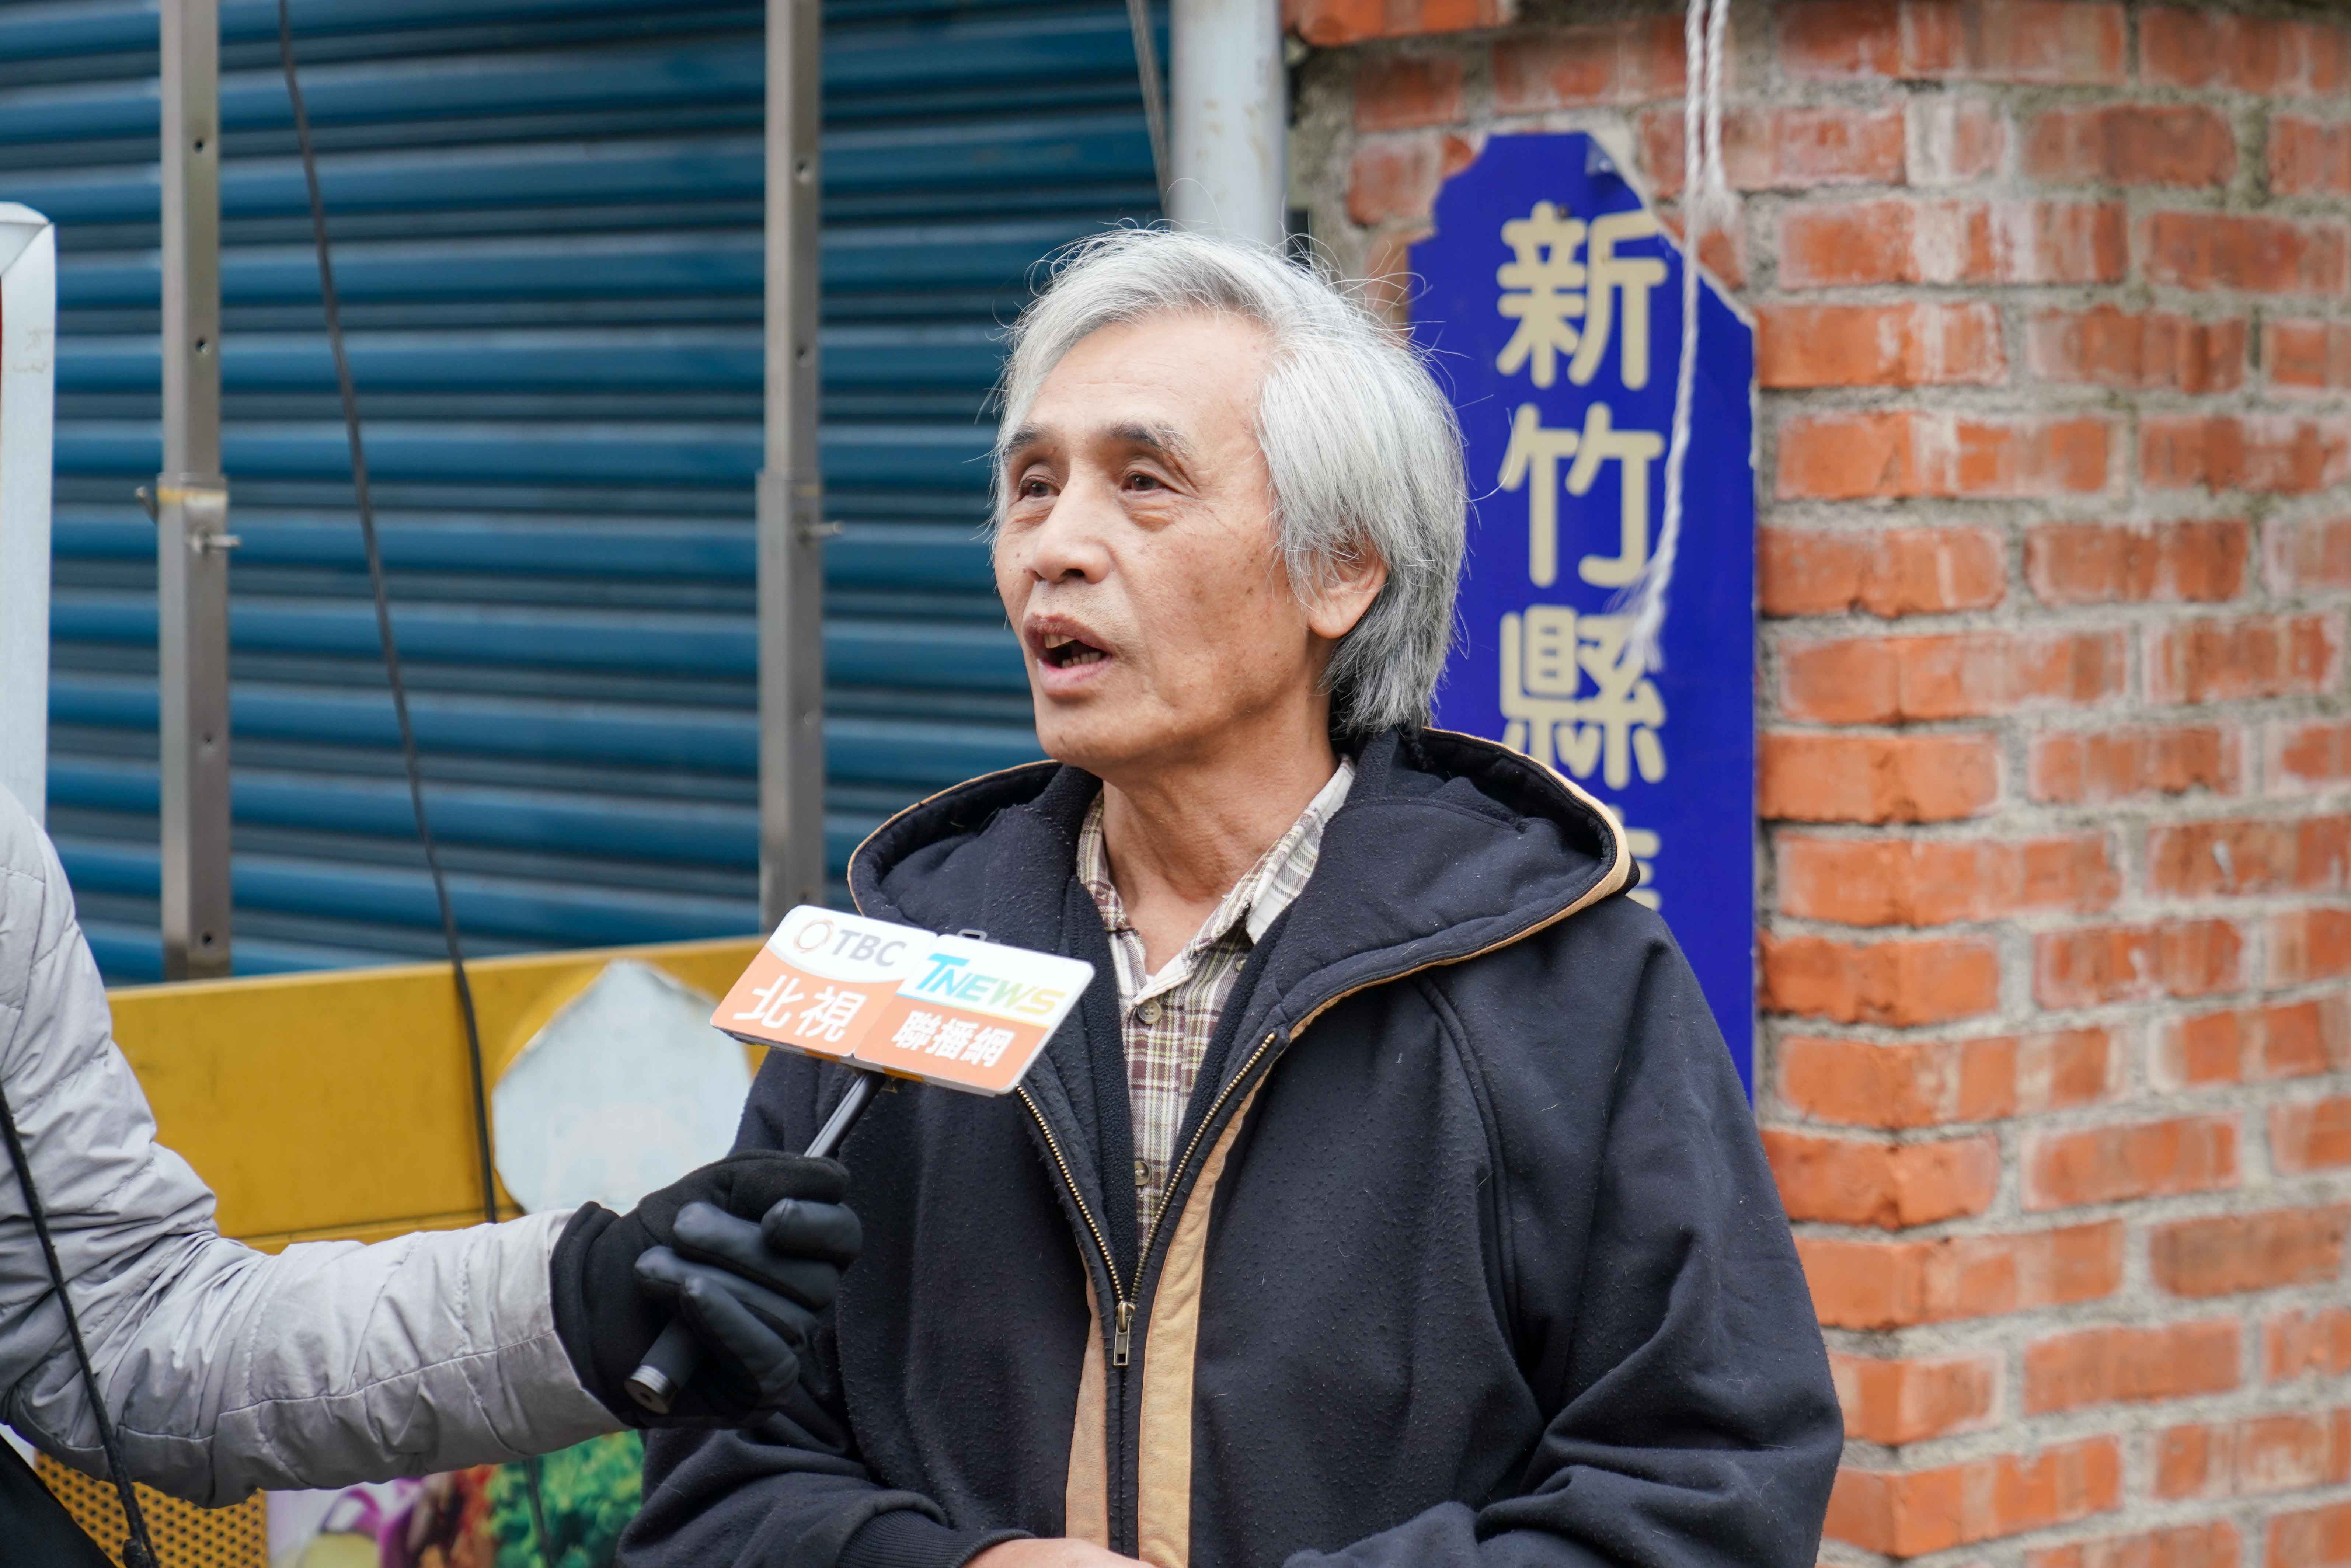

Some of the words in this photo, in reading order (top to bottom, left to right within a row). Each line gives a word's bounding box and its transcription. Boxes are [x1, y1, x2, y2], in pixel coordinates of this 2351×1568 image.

[1496, 201, 1667, 912] 新竹縣
[832, 928, 907, 967] TBC
[734, 975, 866, 1042] 北視
[916, 952, 1066, 1014] TNEWS
[892, 1011, 1015, 1067] 聯播網
